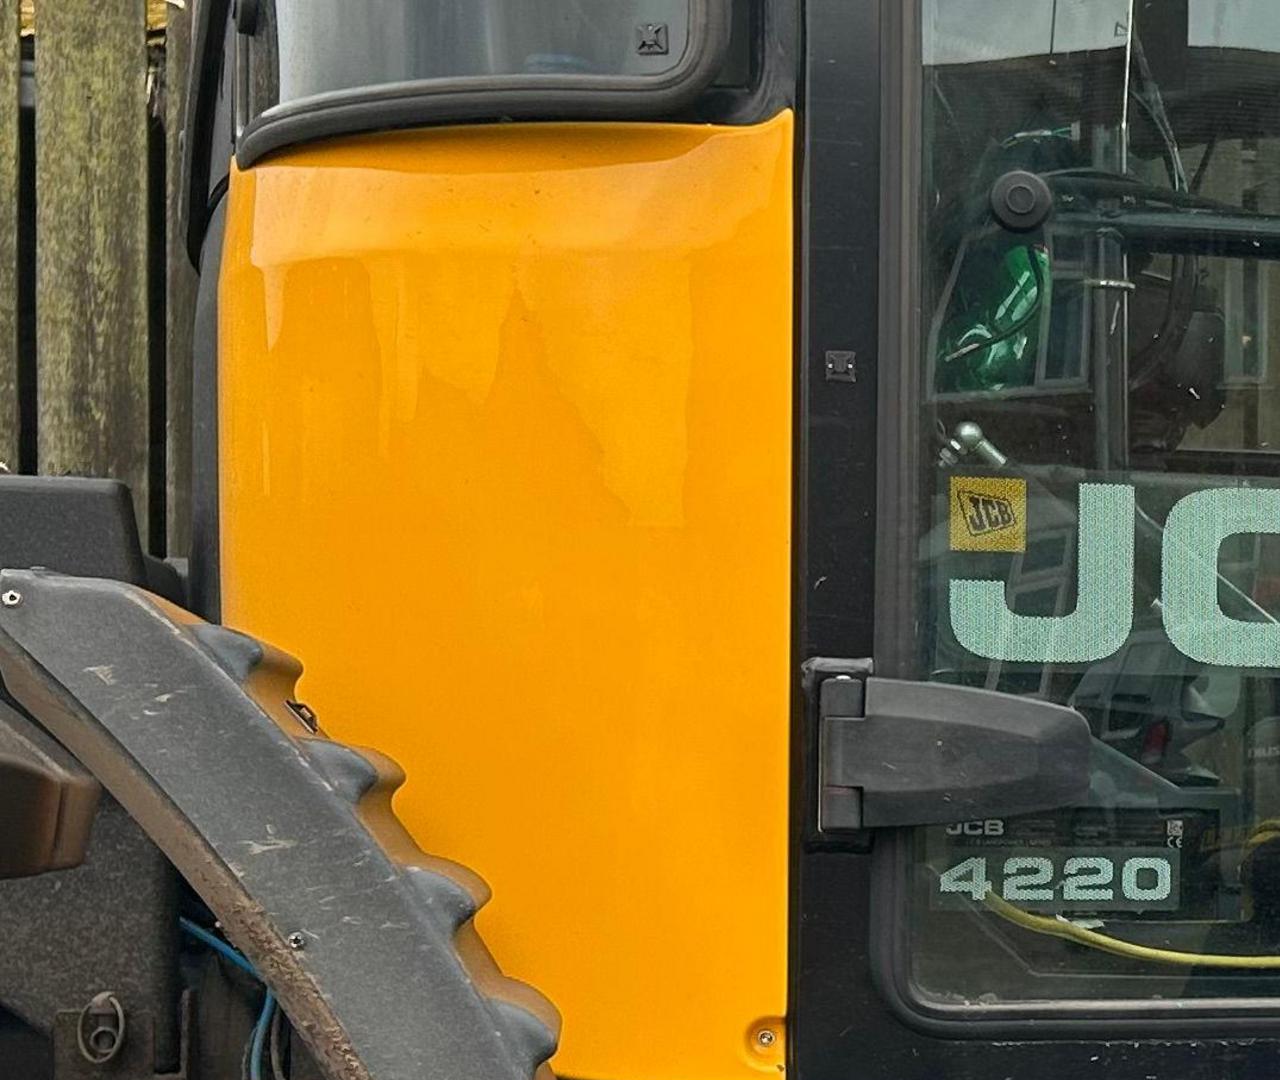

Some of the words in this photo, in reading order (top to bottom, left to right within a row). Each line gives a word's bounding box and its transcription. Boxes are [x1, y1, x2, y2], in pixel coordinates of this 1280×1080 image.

[962, 494, 1014, 533] JCB
[946, 819, 1005, 836] JCB
[939, 856, 1172, 901] 4220
